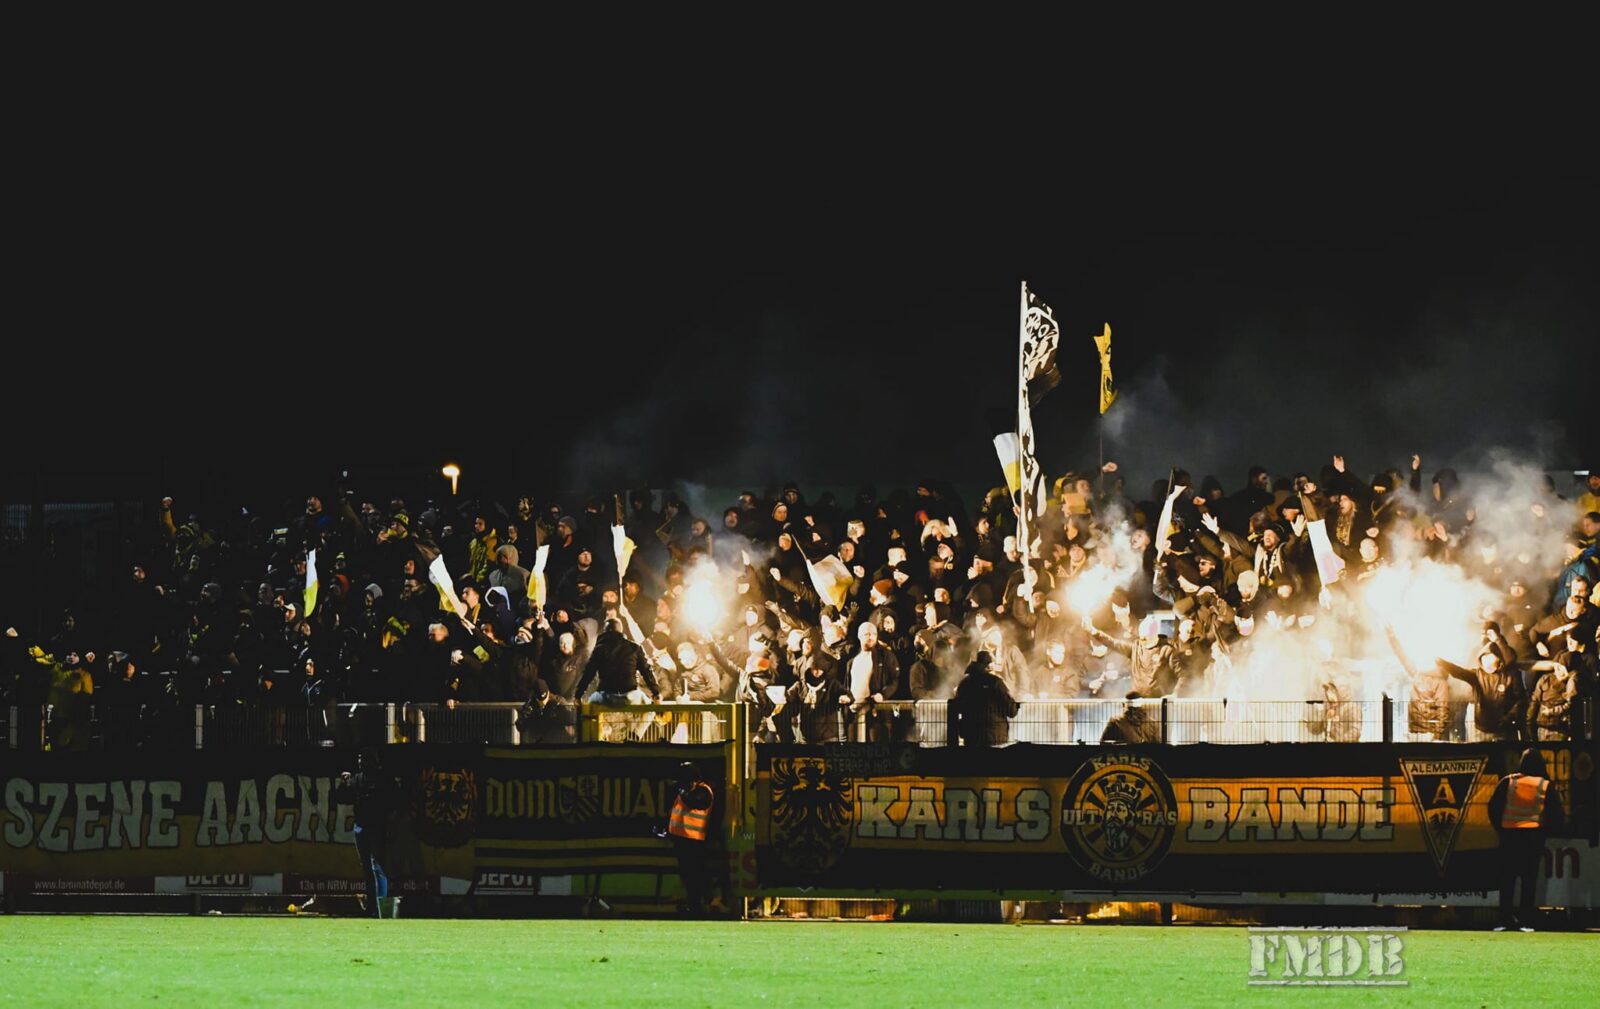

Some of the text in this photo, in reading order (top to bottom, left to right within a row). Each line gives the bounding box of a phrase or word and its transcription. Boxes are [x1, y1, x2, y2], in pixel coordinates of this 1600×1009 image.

[1089, 754, 1151, 771] KARLS
[1411, 761, 1478, 773] ALEMANNIA
[4, 777, 182, 853] SZENE
[855, 785, 1396, 843] KARLS BANDE
[1088, 862, 1149, 881] BANDE
[316, 879, 325, 891] in
[327, 879, 348, 891] NRW
